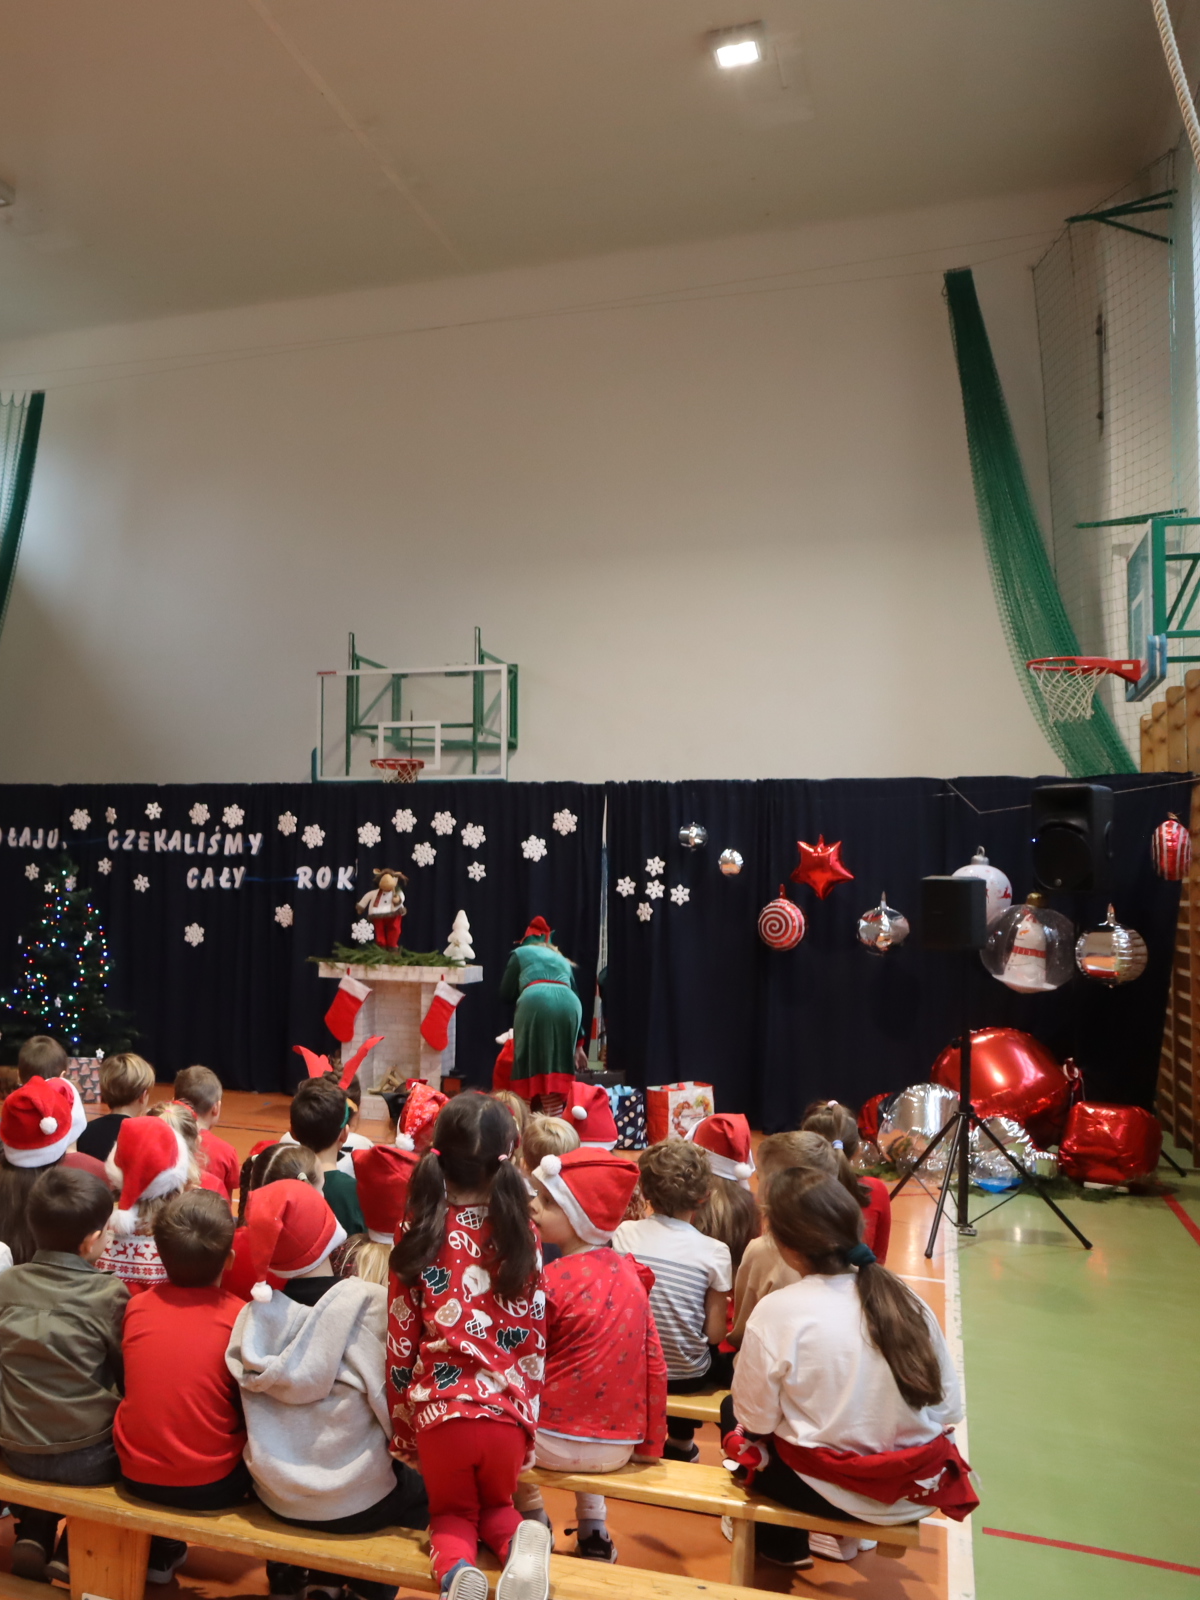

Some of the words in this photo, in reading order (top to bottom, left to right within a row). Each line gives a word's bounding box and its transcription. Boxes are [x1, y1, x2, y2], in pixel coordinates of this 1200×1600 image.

[107, 825, 263, 856] CZEKALIŚMY
[186, 866, 246, 890] CAŁY
[296, 866, 354, 890] ROK
